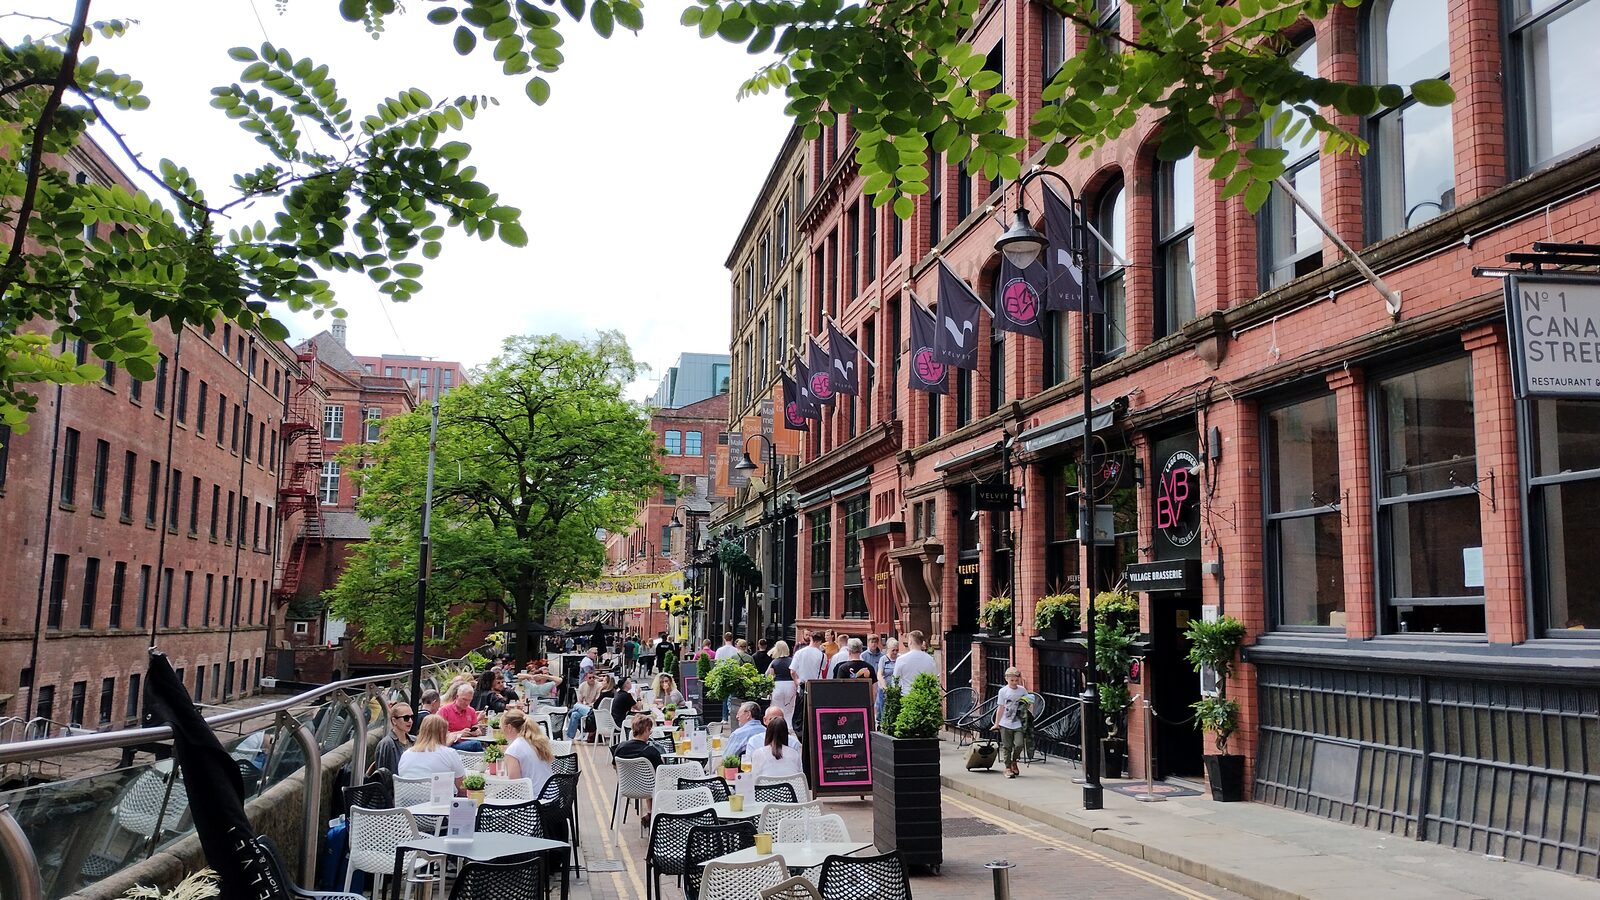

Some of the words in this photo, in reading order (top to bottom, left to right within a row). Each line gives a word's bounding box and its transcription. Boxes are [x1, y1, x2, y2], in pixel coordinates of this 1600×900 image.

[1058, 292, 1095, 301] VELVT
[1558, 291, 1567, 312] 1
[942, 350, 971, 360] VELVET
[1532, 377, 1592, 386] RESTAURANT
[980, 492, 1009, 500] VELVET
[1178, 530, 1194, 544] VELVET
[958, 563, 979, 575] VELVET
[1067, 574, 1080, 582] VELVE
[1129, 570, 1152, 582] VILLAGE
[1152, 569, 1183, 581] BRASSERIE
[633, 582, 658, 590] LIBERTY
[259, 856, 267, 864] &
[264, 866, 279, 893] HOTEL
